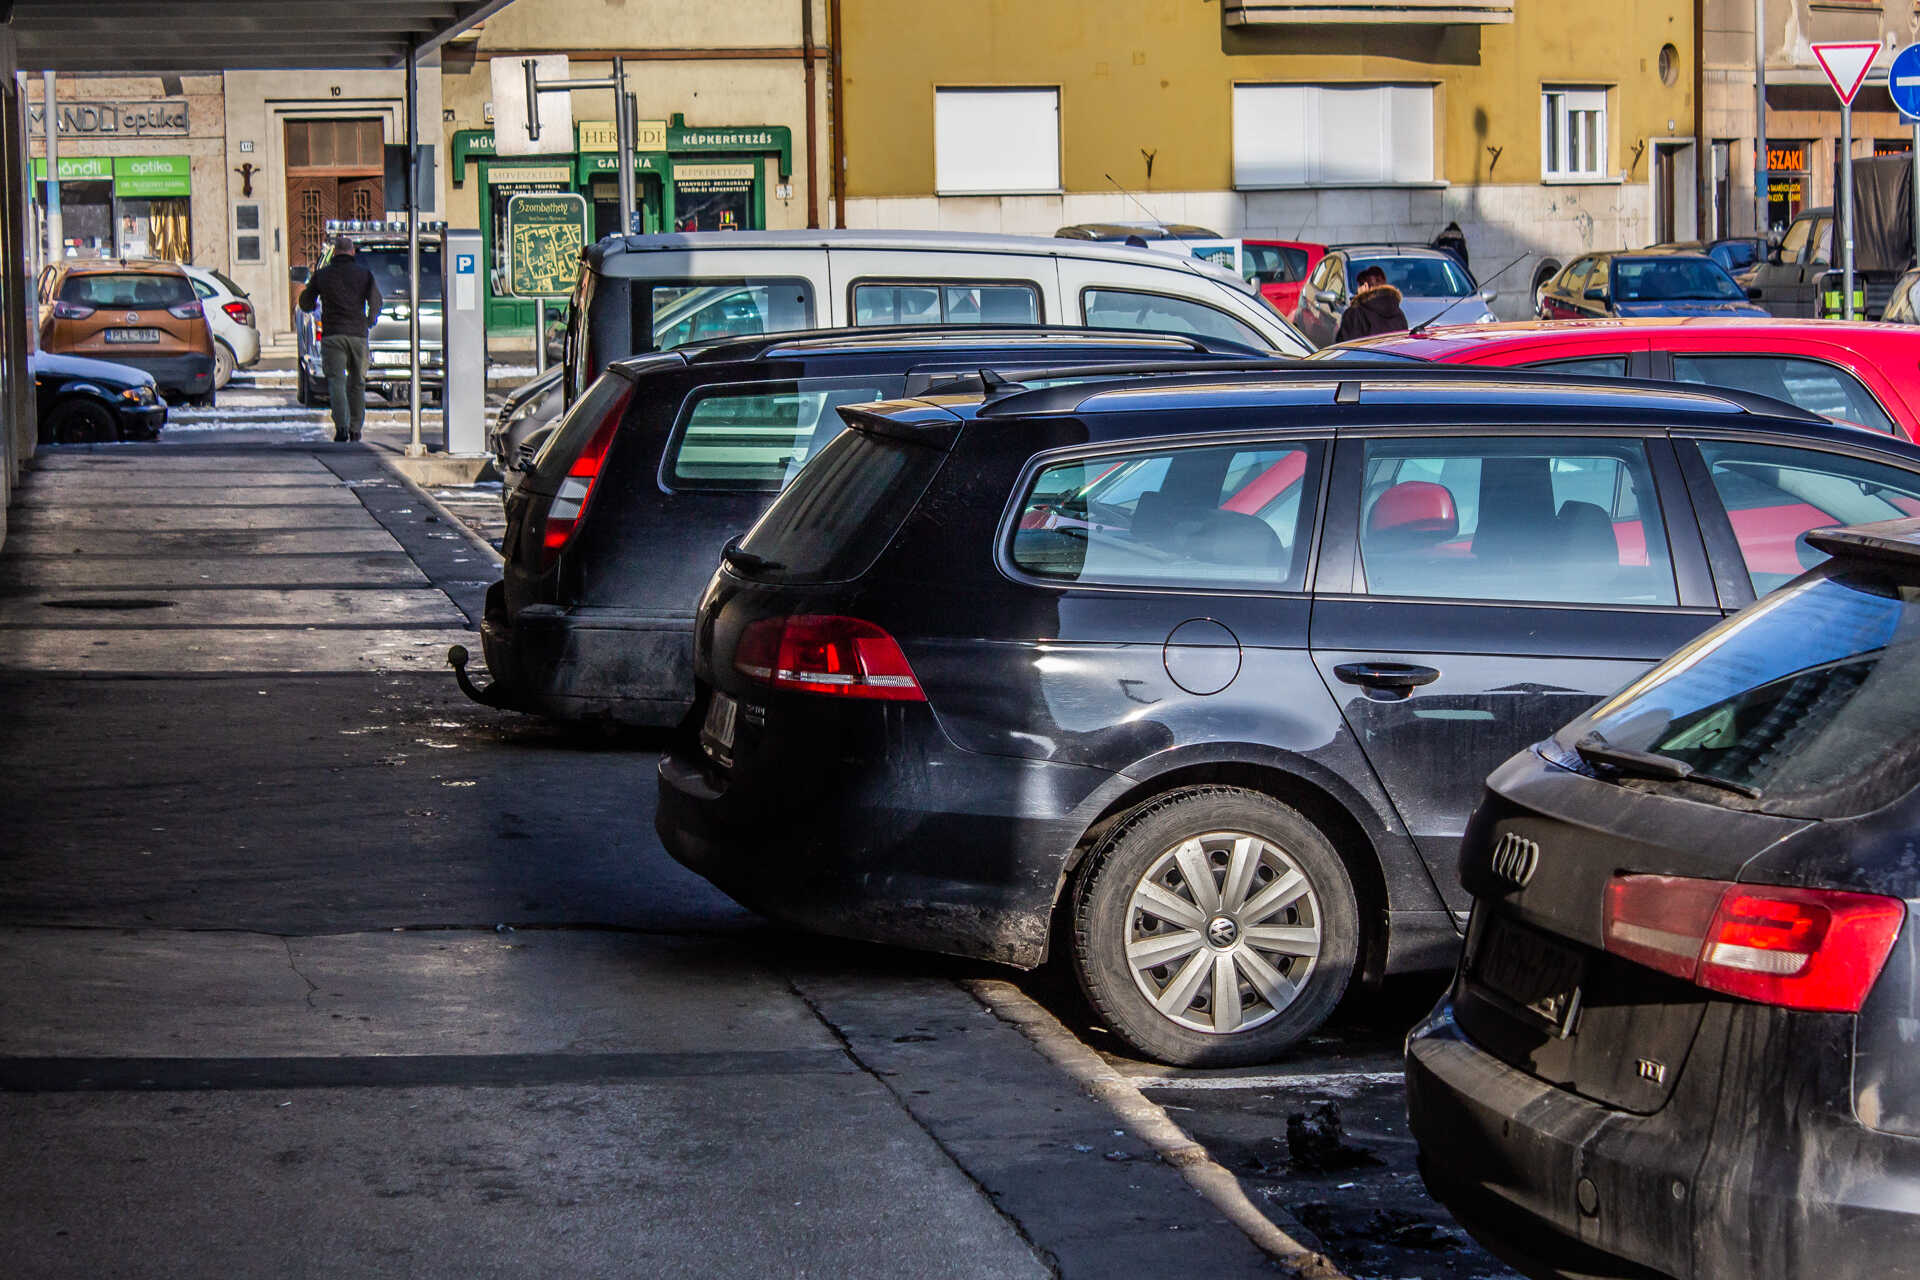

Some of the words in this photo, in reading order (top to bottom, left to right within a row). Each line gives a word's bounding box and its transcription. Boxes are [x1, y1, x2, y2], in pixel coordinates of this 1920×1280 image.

[331, 86, 341, 96] 10
[123, 107, 185, 135] optika
[682, 133, 773, 145] KÉPKERETEZÉS
[58, 160, 101, 176] ándli
[131, 160, 173, 177] optika
[459, 257, 472, 271] P
